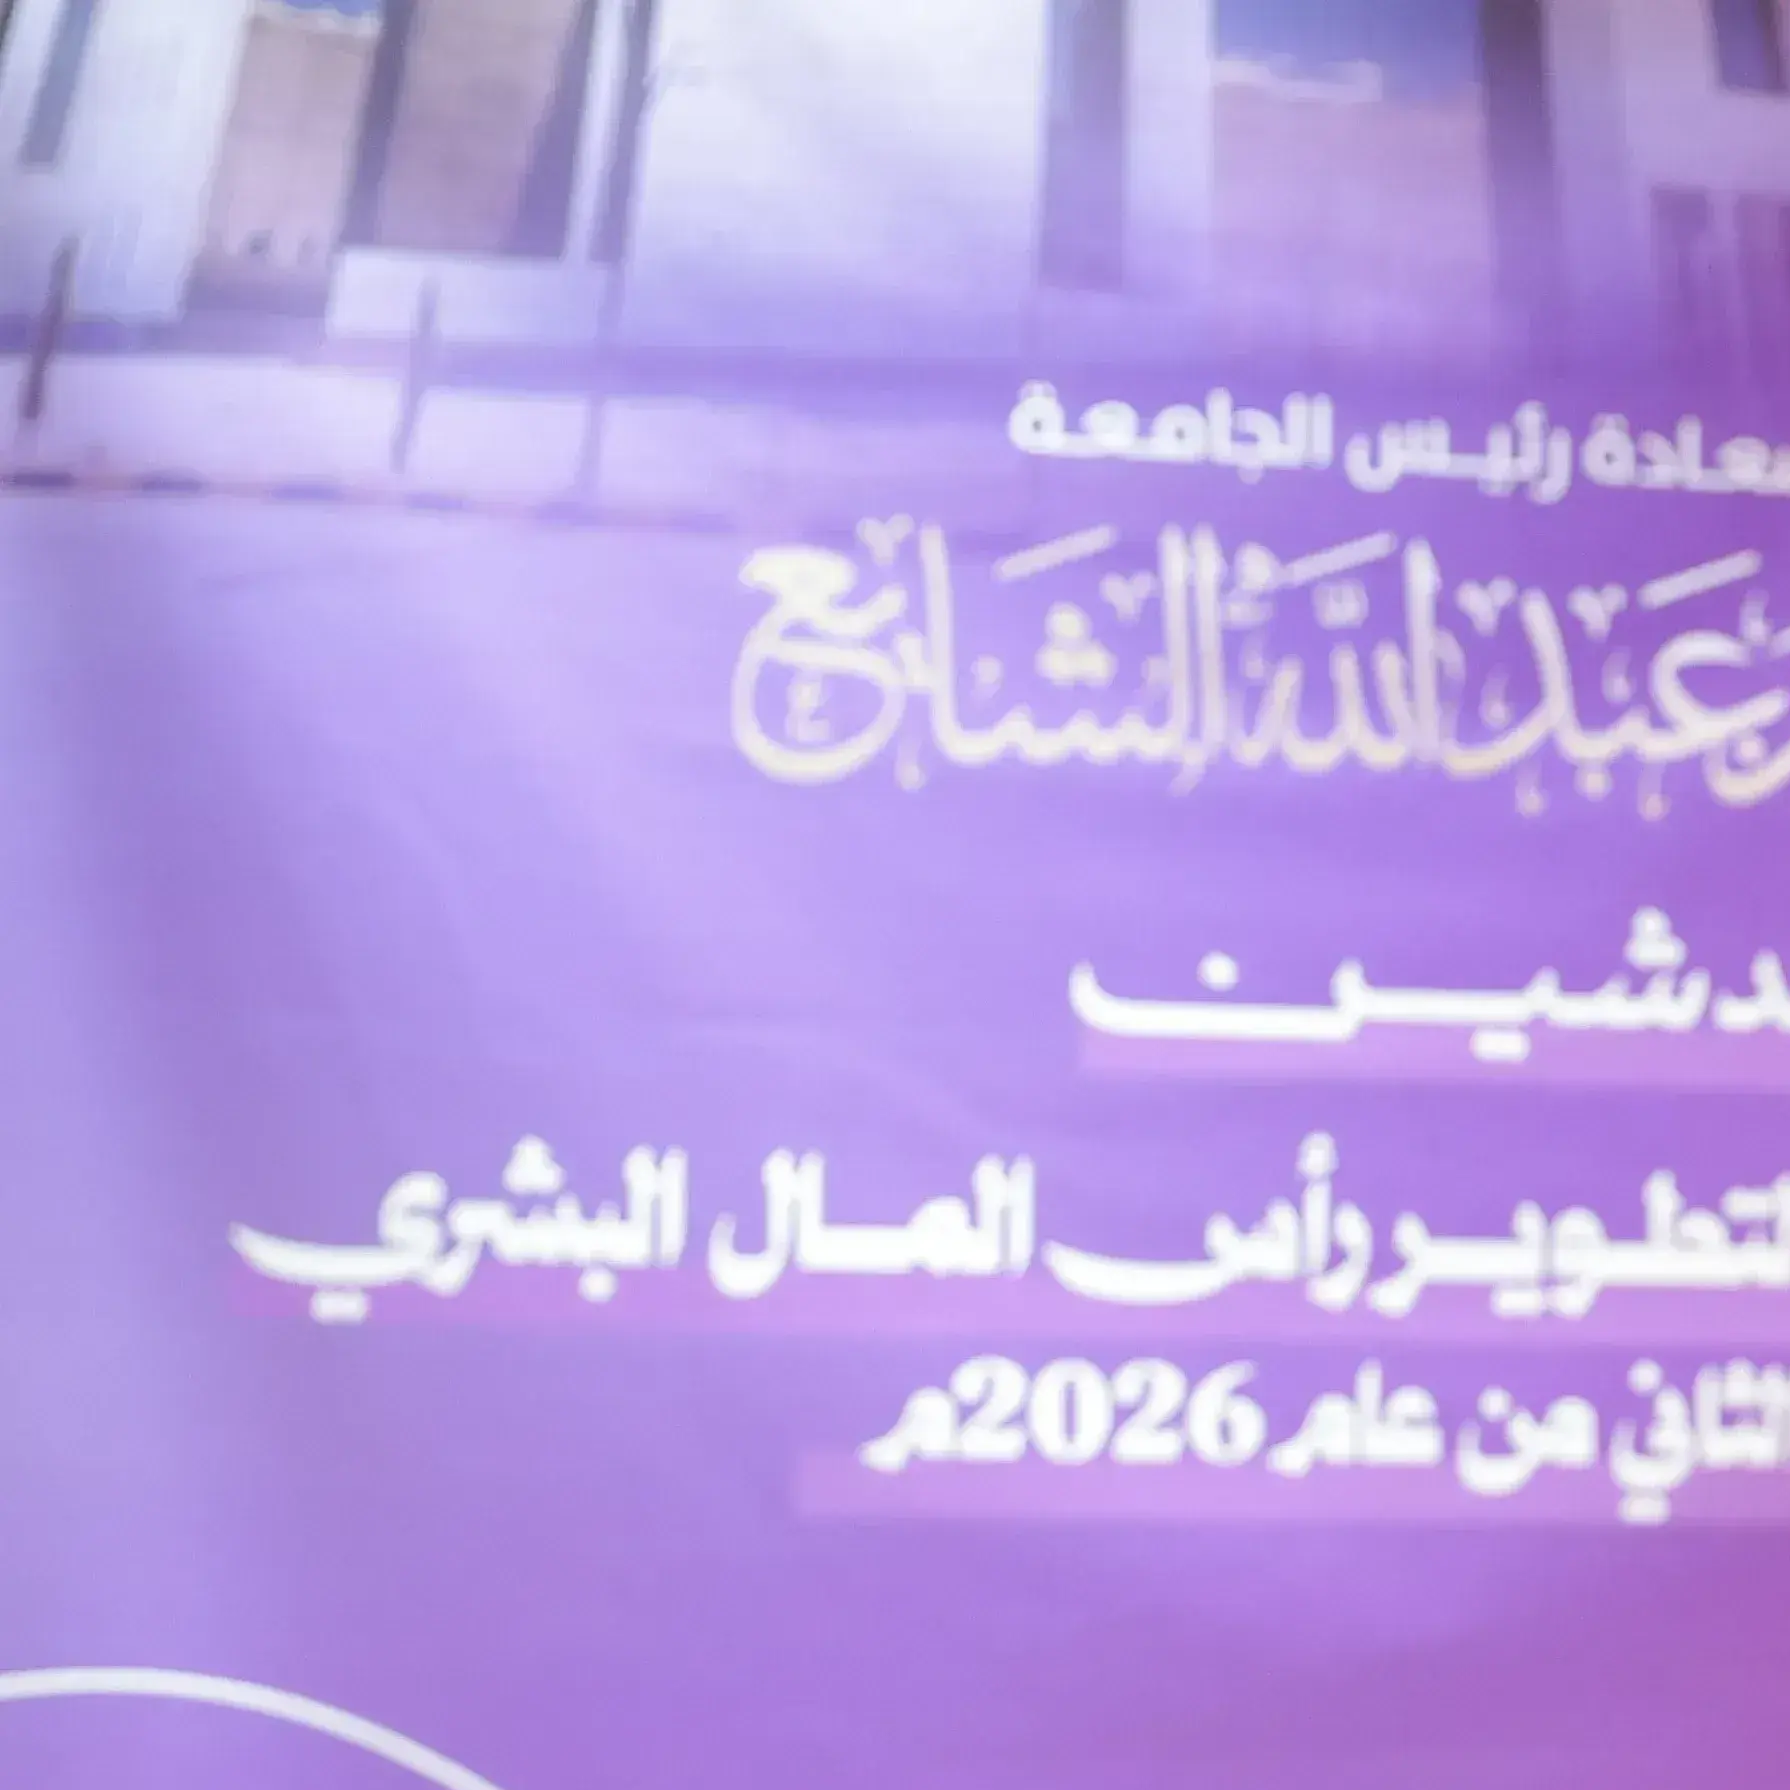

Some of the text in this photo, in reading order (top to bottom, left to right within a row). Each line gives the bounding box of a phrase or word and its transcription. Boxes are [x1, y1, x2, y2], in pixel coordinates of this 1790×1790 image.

[1008, 382, 1334, 481] الجامعة
[1345, 401, 1574, 504] رئيس
[227, 1134, 690, 1324] البشري
[706, 1147, 1036, 1300] المال
[1043, 1130, 1372, 1314] رأس
[1266, 1356, 1444, 1478] عام
[1454, 1385, 1598, 1495] من
